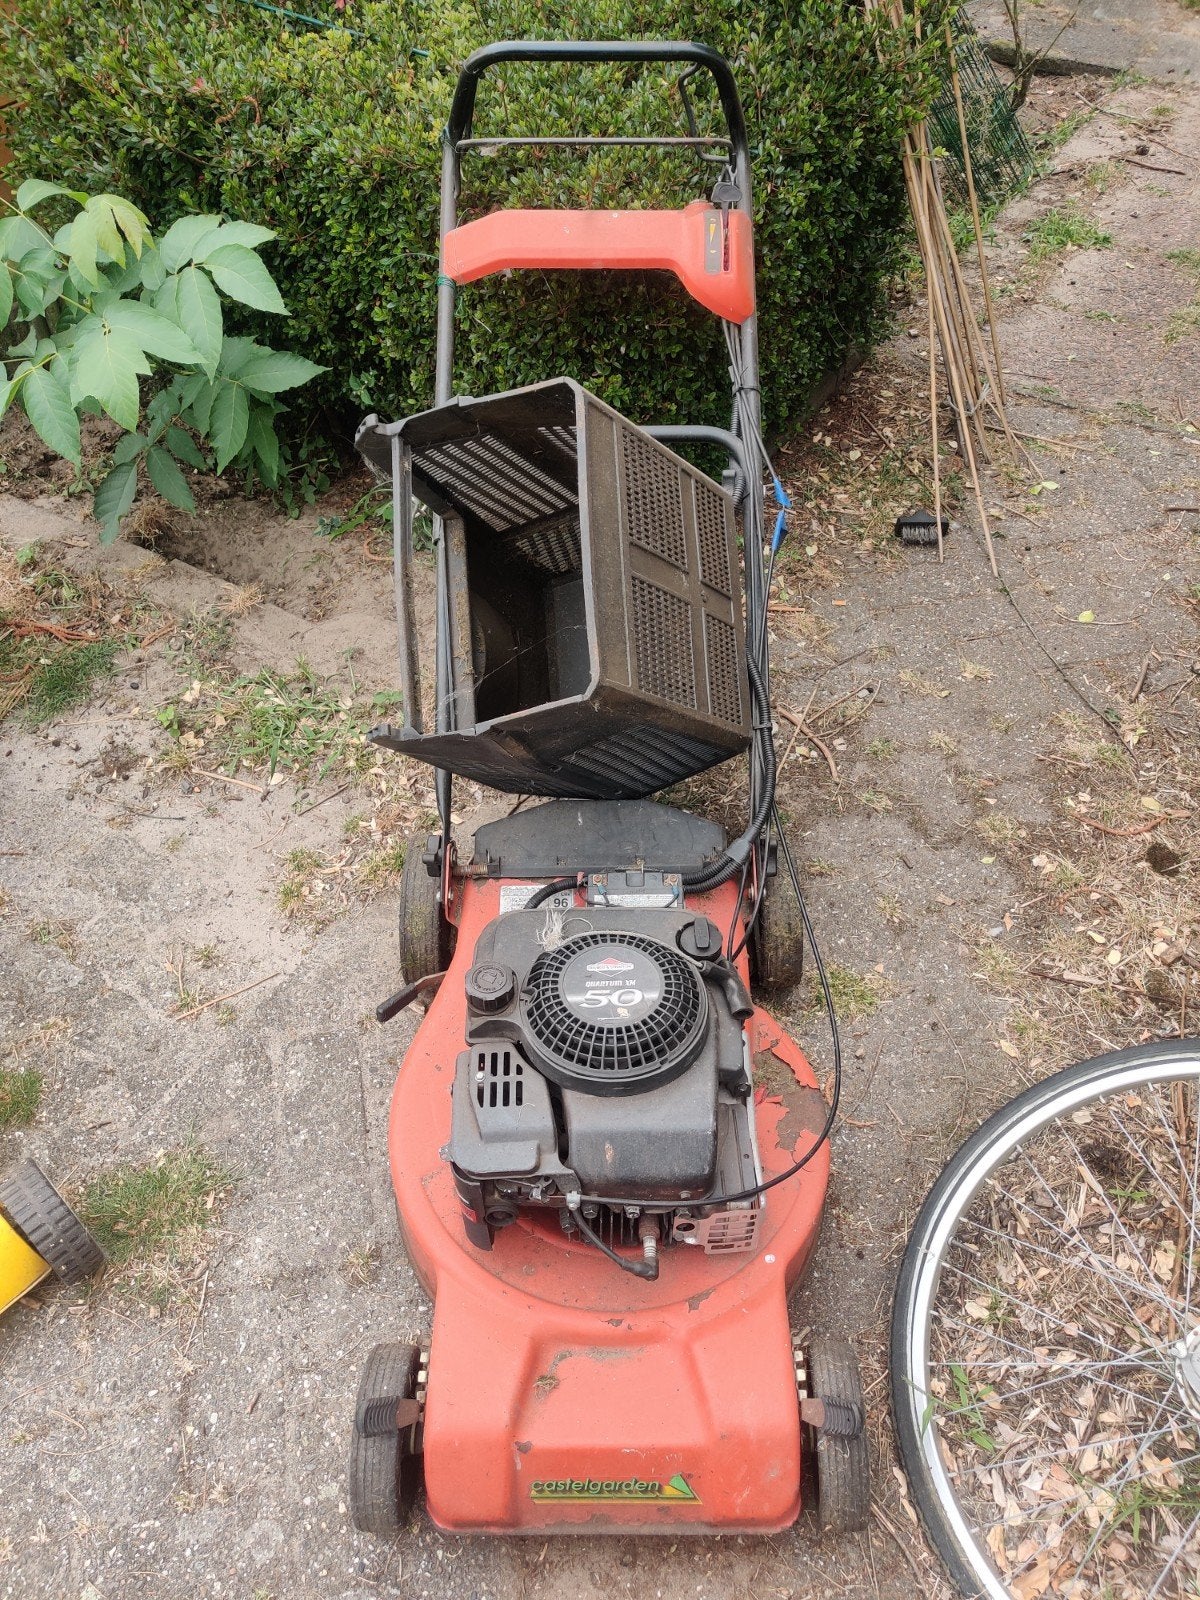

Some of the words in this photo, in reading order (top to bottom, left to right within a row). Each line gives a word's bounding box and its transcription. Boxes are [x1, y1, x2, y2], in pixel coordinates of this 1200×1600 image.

[553, 898, 569, 908] 96
[578, 988, 644, 1009] 50
[531, 1477, 660, 1494] castelgarden
